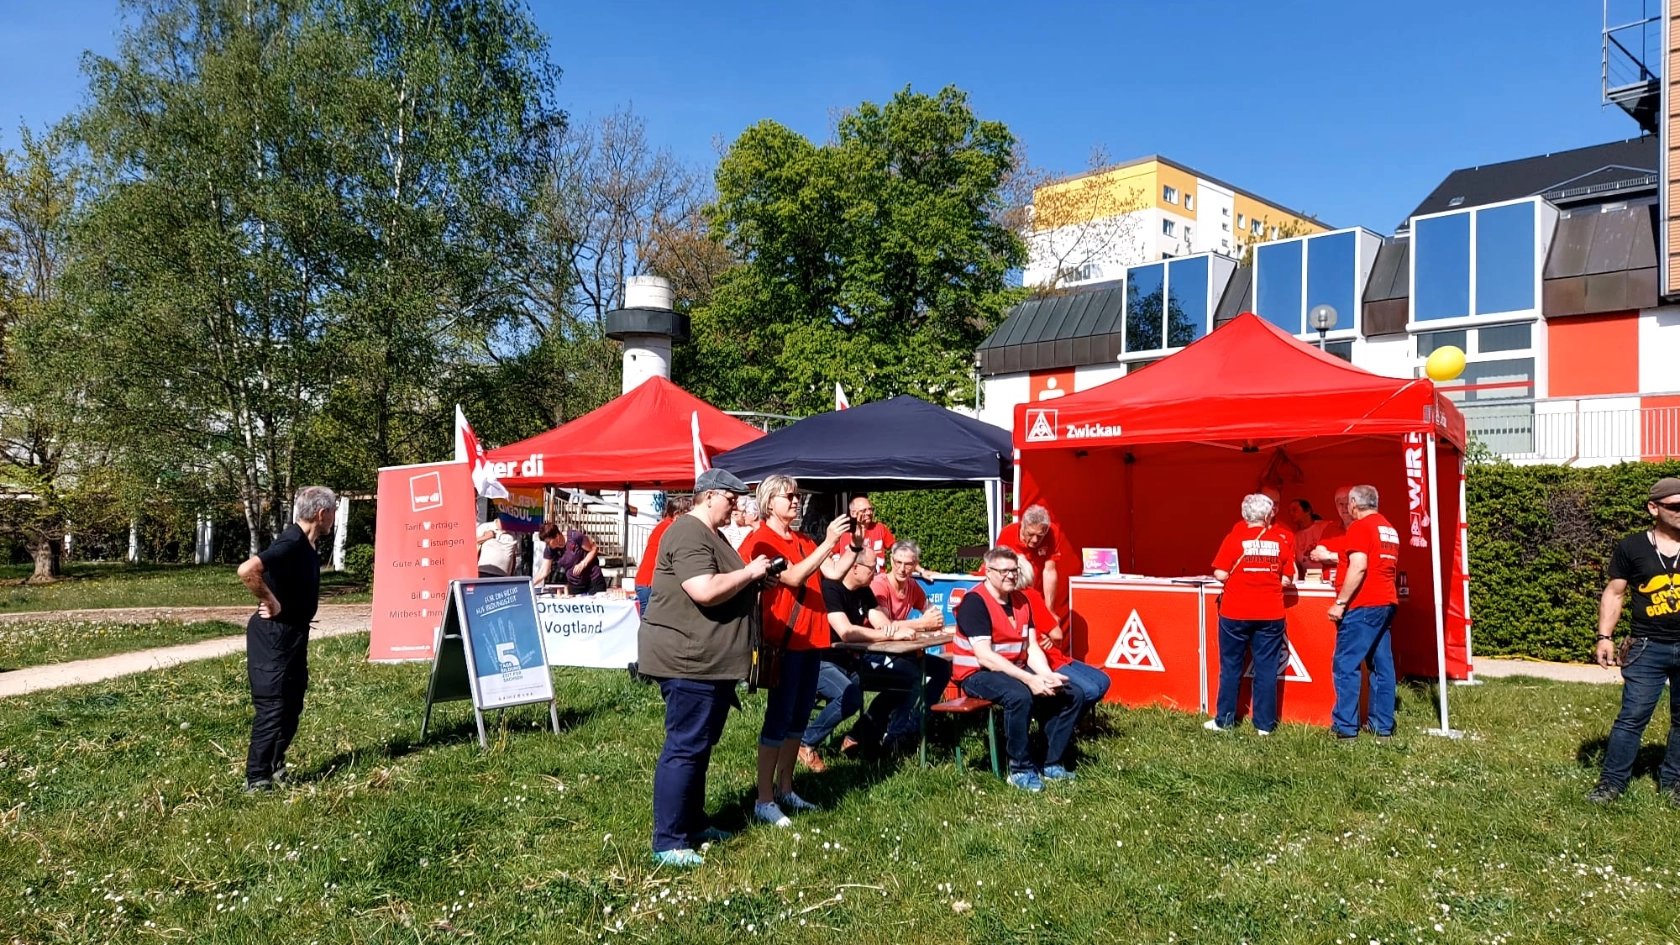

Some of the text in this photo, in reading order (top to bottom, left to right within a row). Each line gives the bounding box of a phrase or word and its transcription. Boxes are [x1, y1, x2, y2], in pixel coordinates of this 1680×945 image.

[1066, 423, 1122, 438] Zwickau
[1405, 447, 1422, 510] WIR
[537, 601, 605, 614] Ortsverein
[544, 620, 603, 637] Vogtland
[496, 642, 520, 668] 5
